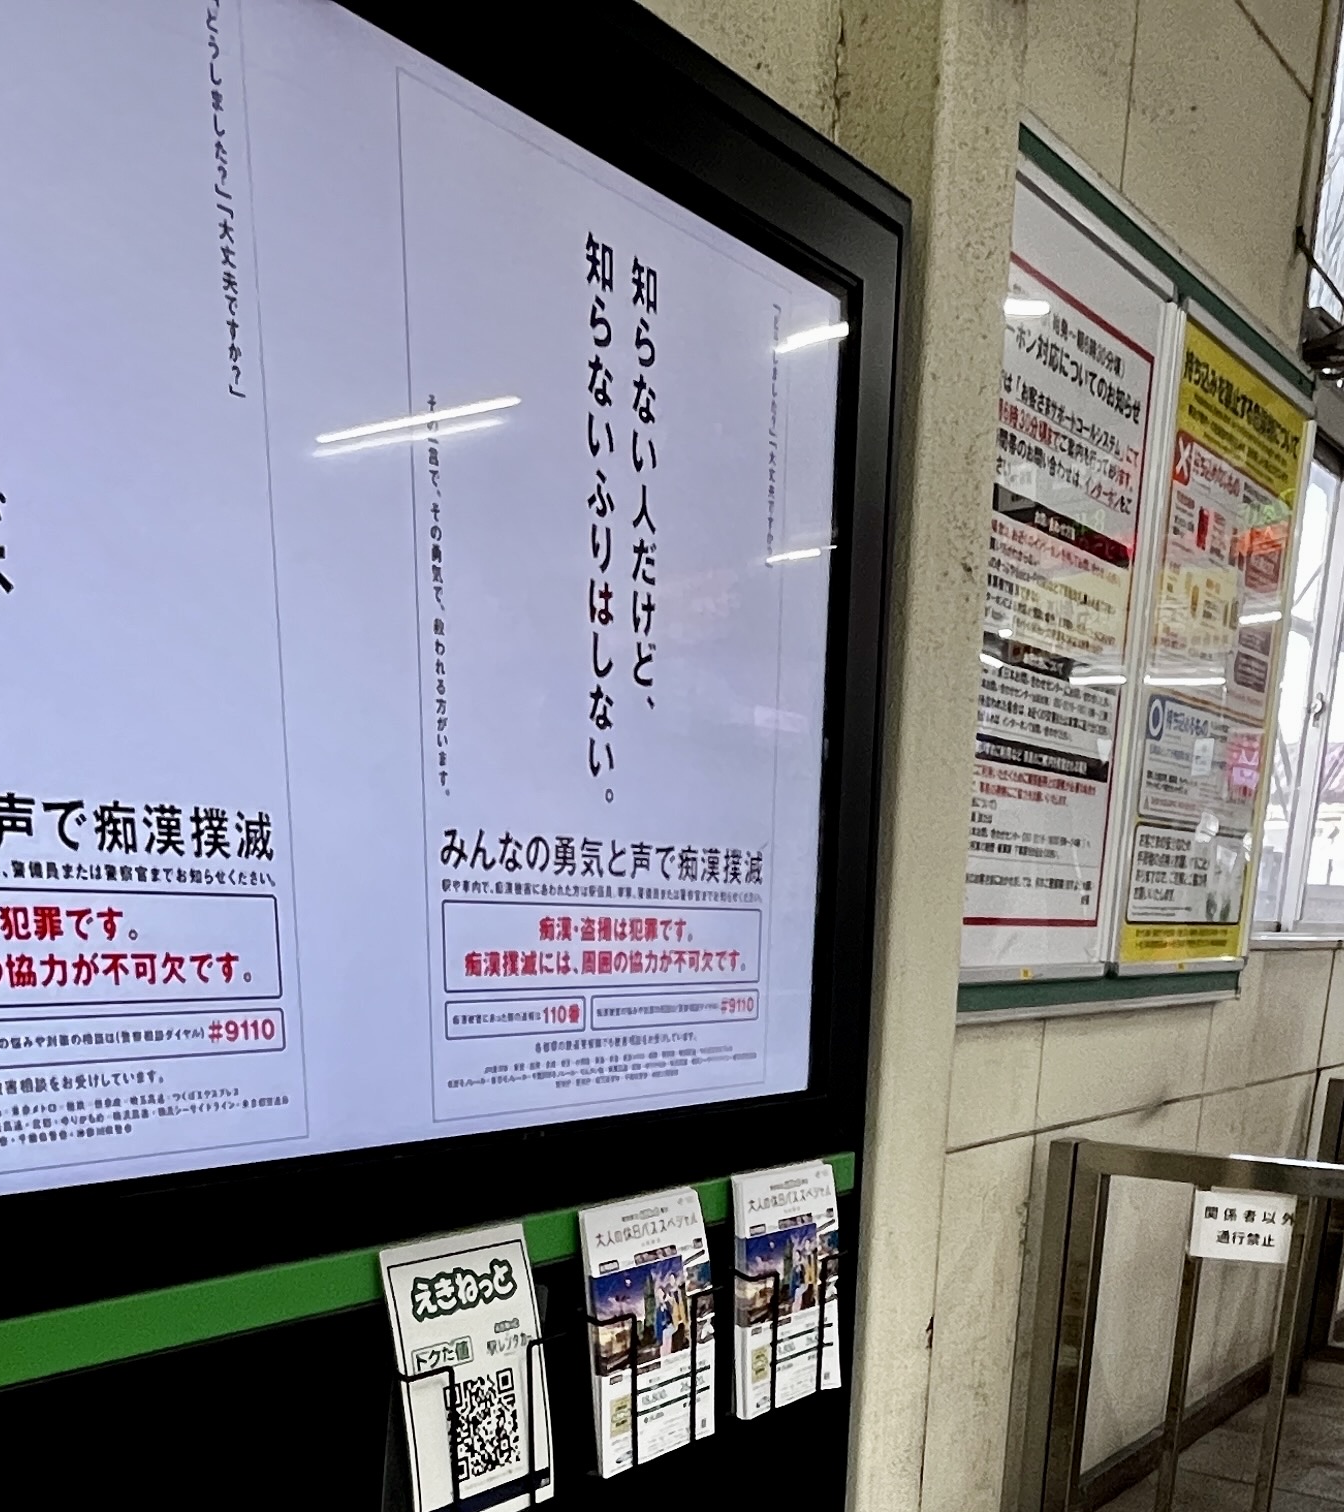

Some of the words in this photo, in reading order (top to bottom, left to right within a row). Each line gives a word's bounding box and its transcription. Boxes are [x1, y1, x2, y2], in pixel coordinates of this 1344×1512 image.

[632, 256, 658, 711] 知らない人だけど、
[585, 231, 615, 803] 知らないふりはしない。
[439, 829, 764, 885] みんなの勇気と声で痴漢撲滅
[539, 916, 694, 942] 痴漢・盗撮は犯罪です。
[464, 950, 747, 977] 痴漢撲滅には、周囲の協力が不可欠です。
[208, 1018, 276, 1042] #9110
[1204, 1205, 1296, 1227] 関係者以外
[1216, 1230, 1276, 1248] 通行禁止
[412, 1259, 517, 1321] えきねっと
